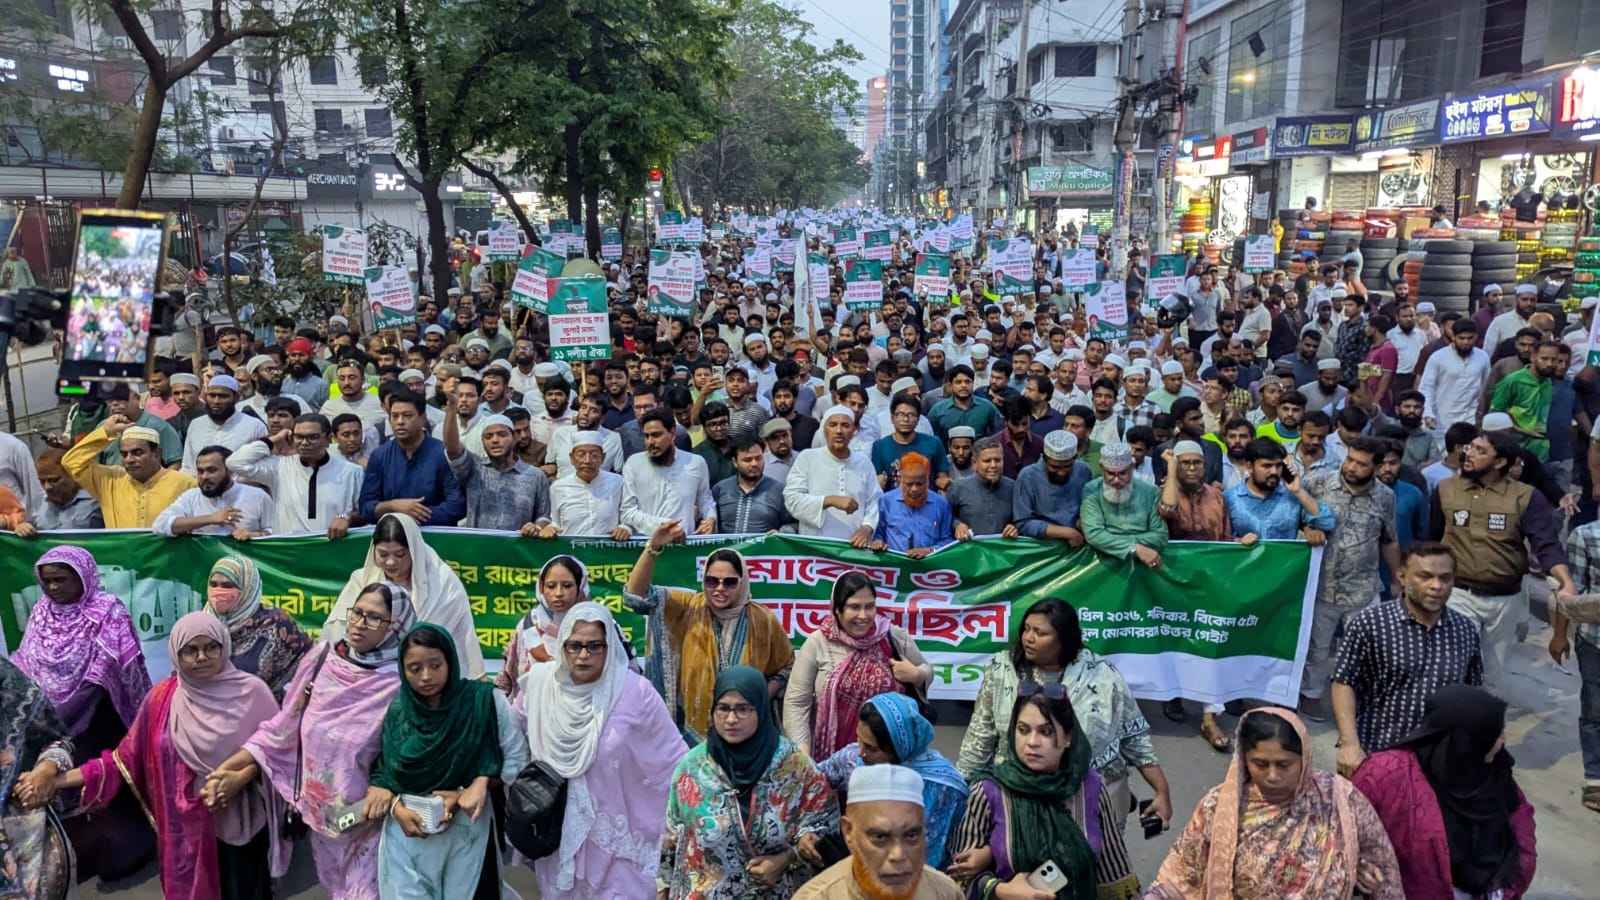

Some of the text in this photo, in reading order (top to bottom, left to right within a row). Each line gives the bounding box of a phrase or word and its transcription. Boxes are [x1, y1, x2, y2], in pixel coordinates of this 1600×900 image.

[374, 172, 406, 191] BYD
[697, 556, 961, 589] মাবেশ ও
[493, 590, 538, 615] প্রতি
[1078, 607, 1104, 623] প্রিল
